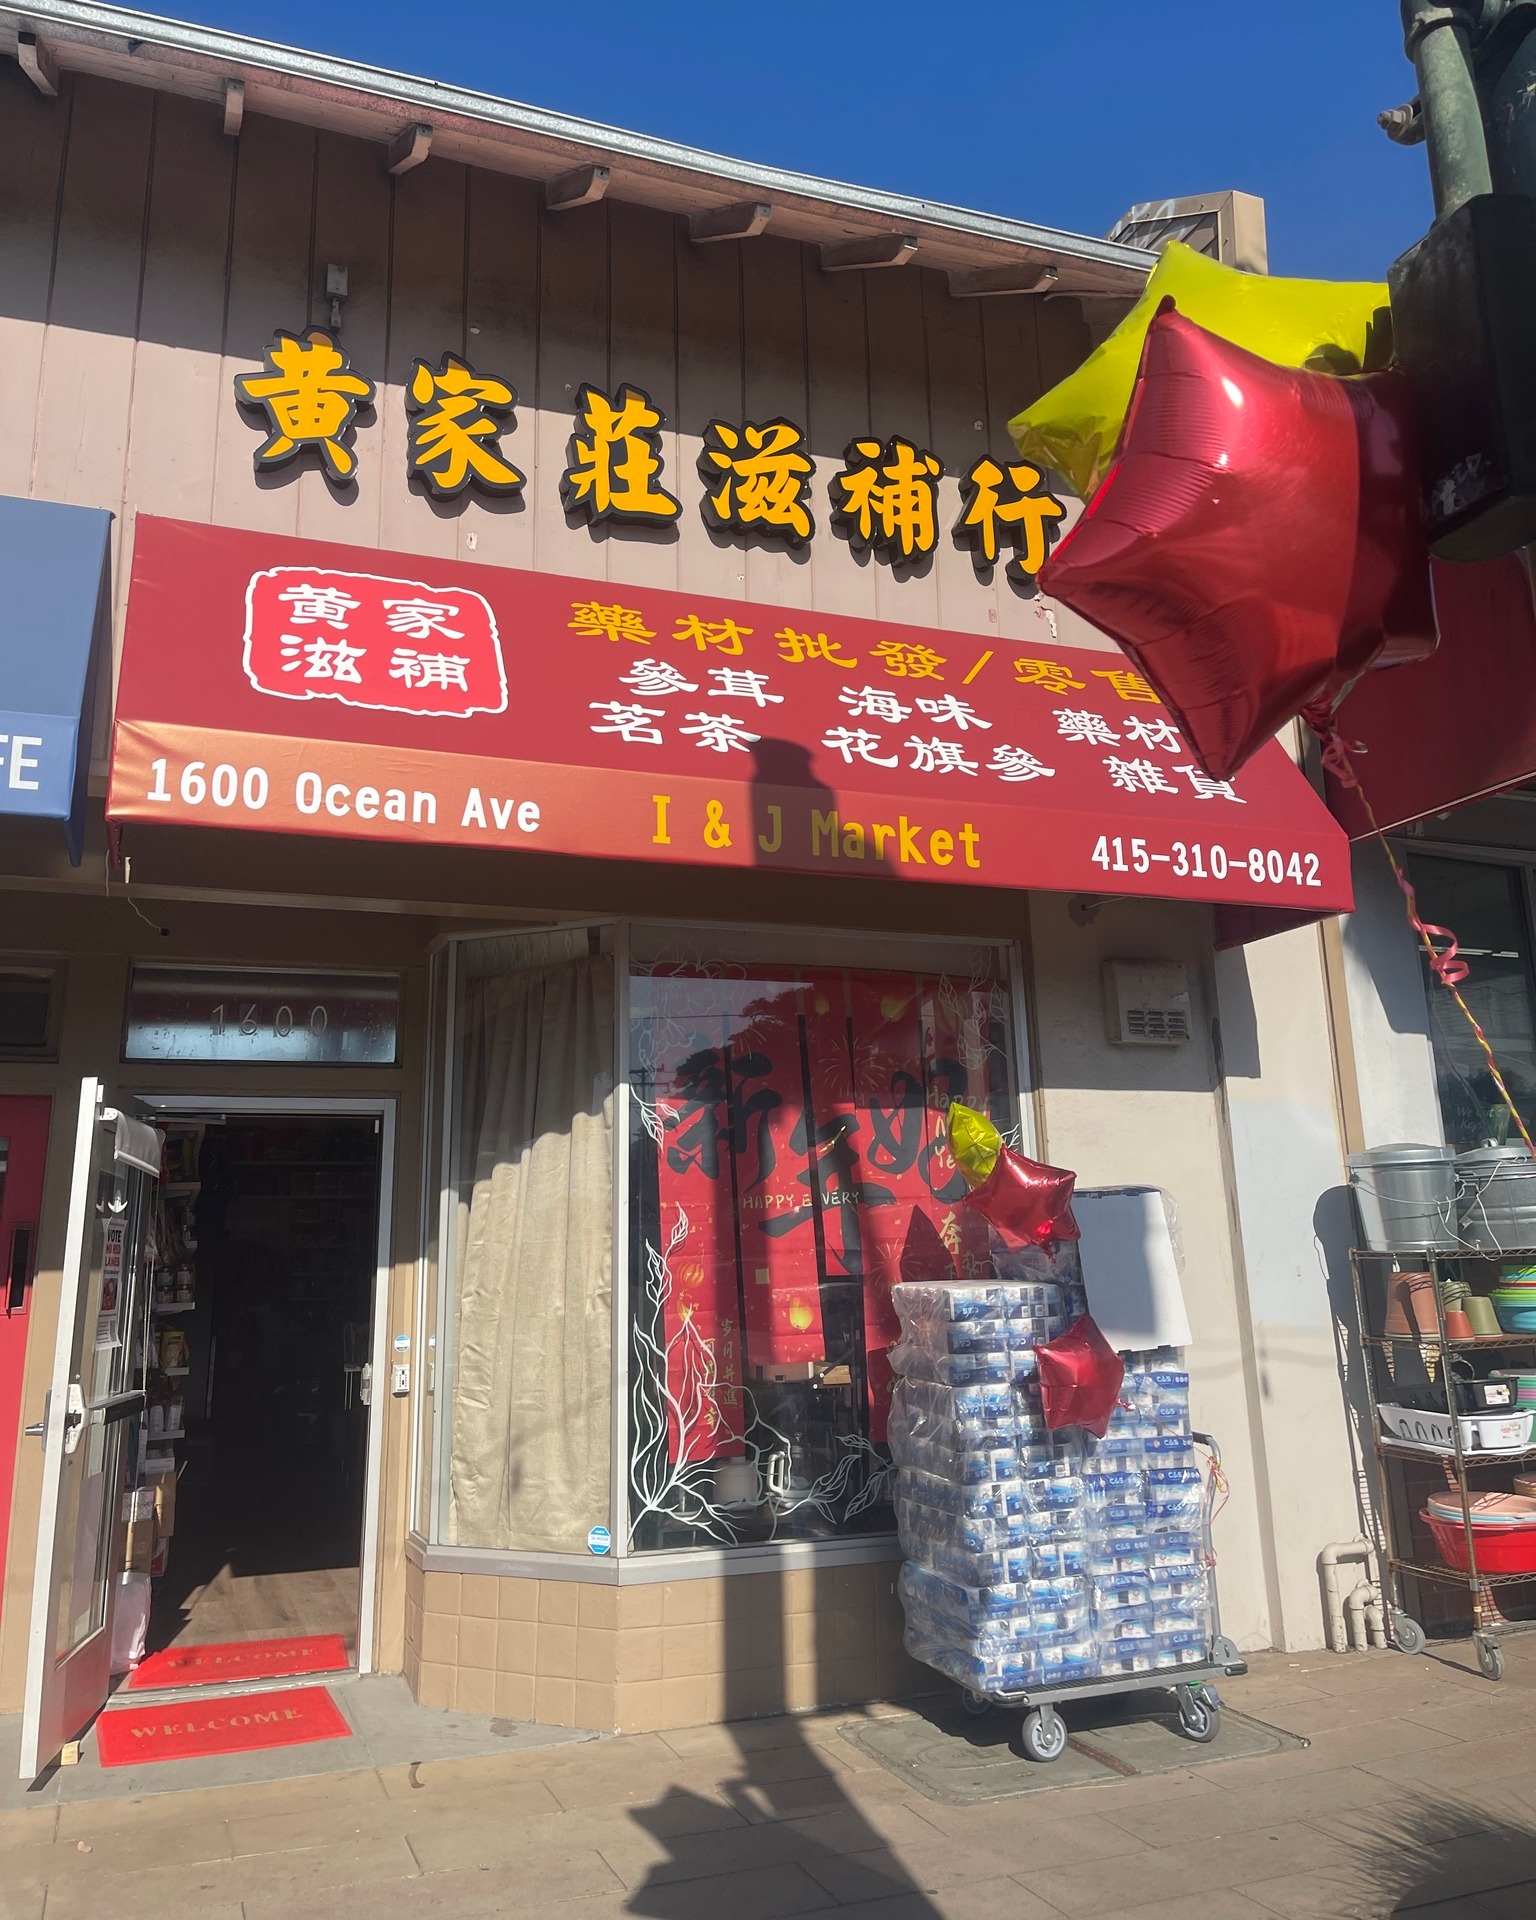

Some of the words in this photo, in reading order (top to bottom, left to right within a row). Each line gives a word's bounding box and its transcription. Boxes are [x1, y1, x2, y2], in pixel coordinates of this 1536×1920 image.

[279, 634, 471, 692] 滋補
[838, 685, 994, 731] 海味
[1052, 706, 1182, 755] 藥材
[588, 700, 762, 753] 茗茶
[820, 726, 1056, 783] 花旗參
[1102, 755, 1248, 804] 雜貨
[147, 757, 269, 810] 1600
[295, 772, 437, 825] Ocean
[461, 787, 541, 833] Ave
[652, 795, 671, 844] I
[703, 799, 733, 849] &
[758, 805, 783, 853] J
[811, 808, 981, 868] Market
[1091, 835, 1323, 887] 415-310-8042
[212, 1003, 328, 1037] 1600
[1457, 1106, 1473, 1118] We
[743, 1193, 794, 1209] HAPPY
[107, 1229, 122, 1243] VOTE
[166, 1647, 319, 1667] WELCOME
[130, 1708, 303, 1739] WELCOME
